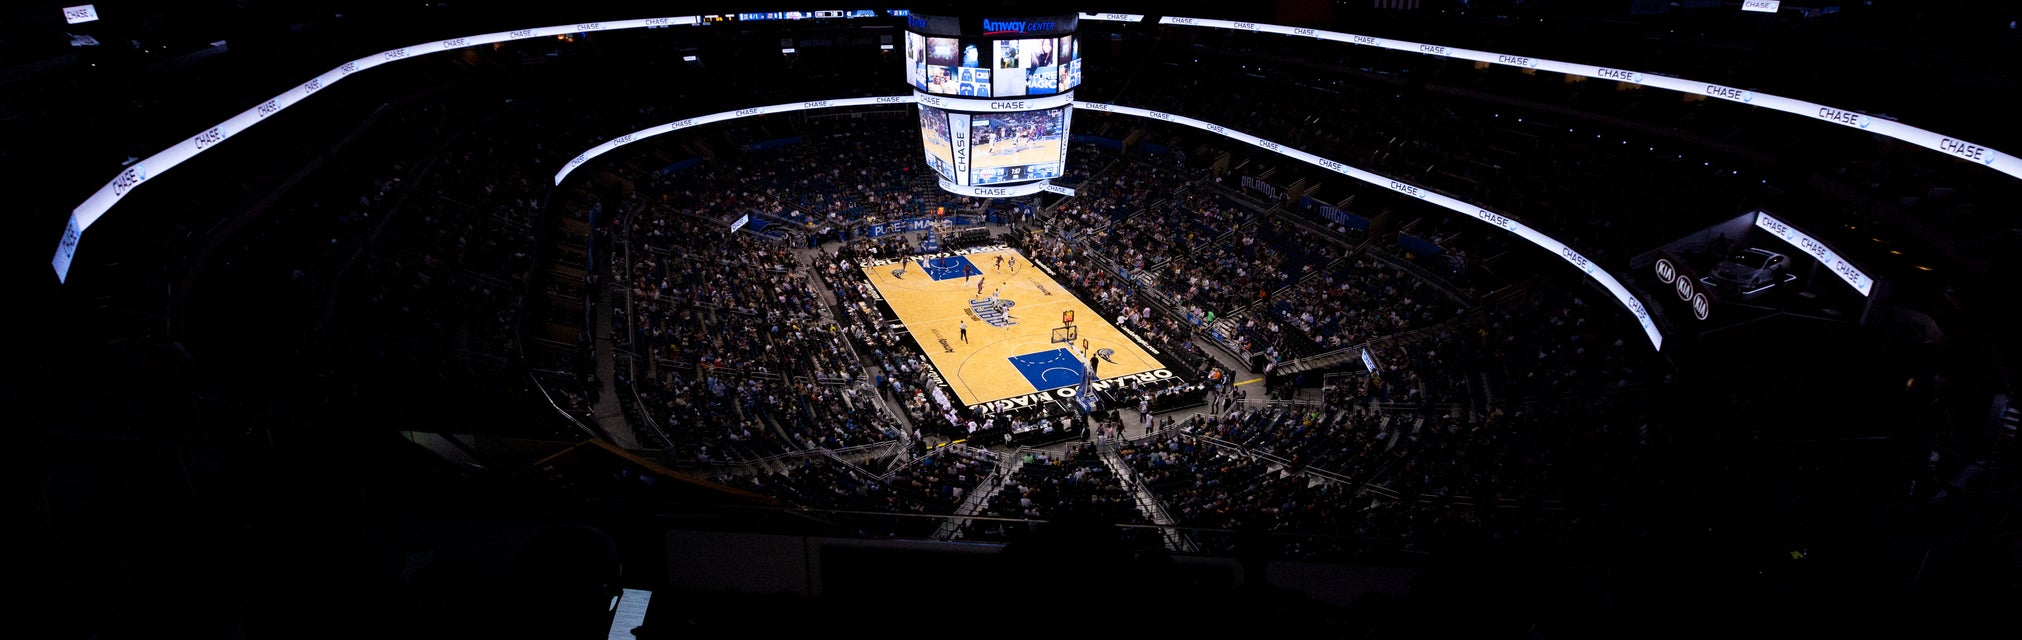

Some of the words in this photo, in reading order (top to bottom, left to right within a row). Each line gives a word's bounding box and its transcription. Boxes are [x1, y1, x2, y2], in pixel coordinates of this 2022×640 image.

[1745, 1, 1770, 9] CHASE
[66, 9, 88, 20] CHASE
[576, 23, 600, 31] CHASE
[983, 19, 1026, 33] Amway
[1027, 21, 1055, 30] CENTER
[1294, 28, 1315, 36] CHASE
[509, 29, 531, 39] CHASE
[1353, 36, 1375, 45] CHASE
[443, 38, 465, 48] CHASE
[1419, 44, 1445, 54] CHASE
[384, 49, 405, 61] CHASE
[1498, 55, 1529, 66] CHASE
[1597, 68, 1634, 81] CHASE
[1706, 85, 1743, 100] CHASE
[257, 100, 277, 117] CHASE
[991, 101, 1025, 110] CHASE
[1085, 102, 1108, 110] CHASE
[735, 108, 758, 117] CHASE
[1149, 111, 1170, 120] CHASE
[1818, 107, 1859, 125] CHASE
[671, 119, 692, 129] CHASE
[1206, 123, 1224, 134] CHASE
[195, 128, 221, 149] CHASE
[613, 134, 632, 147] CHASE
[1259, 139, 1279, 151] CHASE
[956, 132, 966, 172] CHASE
[1939, 138, 1985, 161] CHASE
[1318, 158, 1342, 172] CHASE
[112, 168, 138, 196] CHASE
[1390, 181, 1419, 196] CHASE
[974, 188, 1006, 196] CHASE
[1478, 210, 1509, 228] CHASE
[1762, 216, 1787, 236] CHASE
[1801, 238, 1826, 258] CHASE
[1562, 247, 1588, 269] CHASE
[1658, 262, 1673, 281] KIA
[1836, 260, 1860, 283] CHASE
[1678, 279, 1691, 298] KIA
[1694, 297, 1708, 316] KIA
